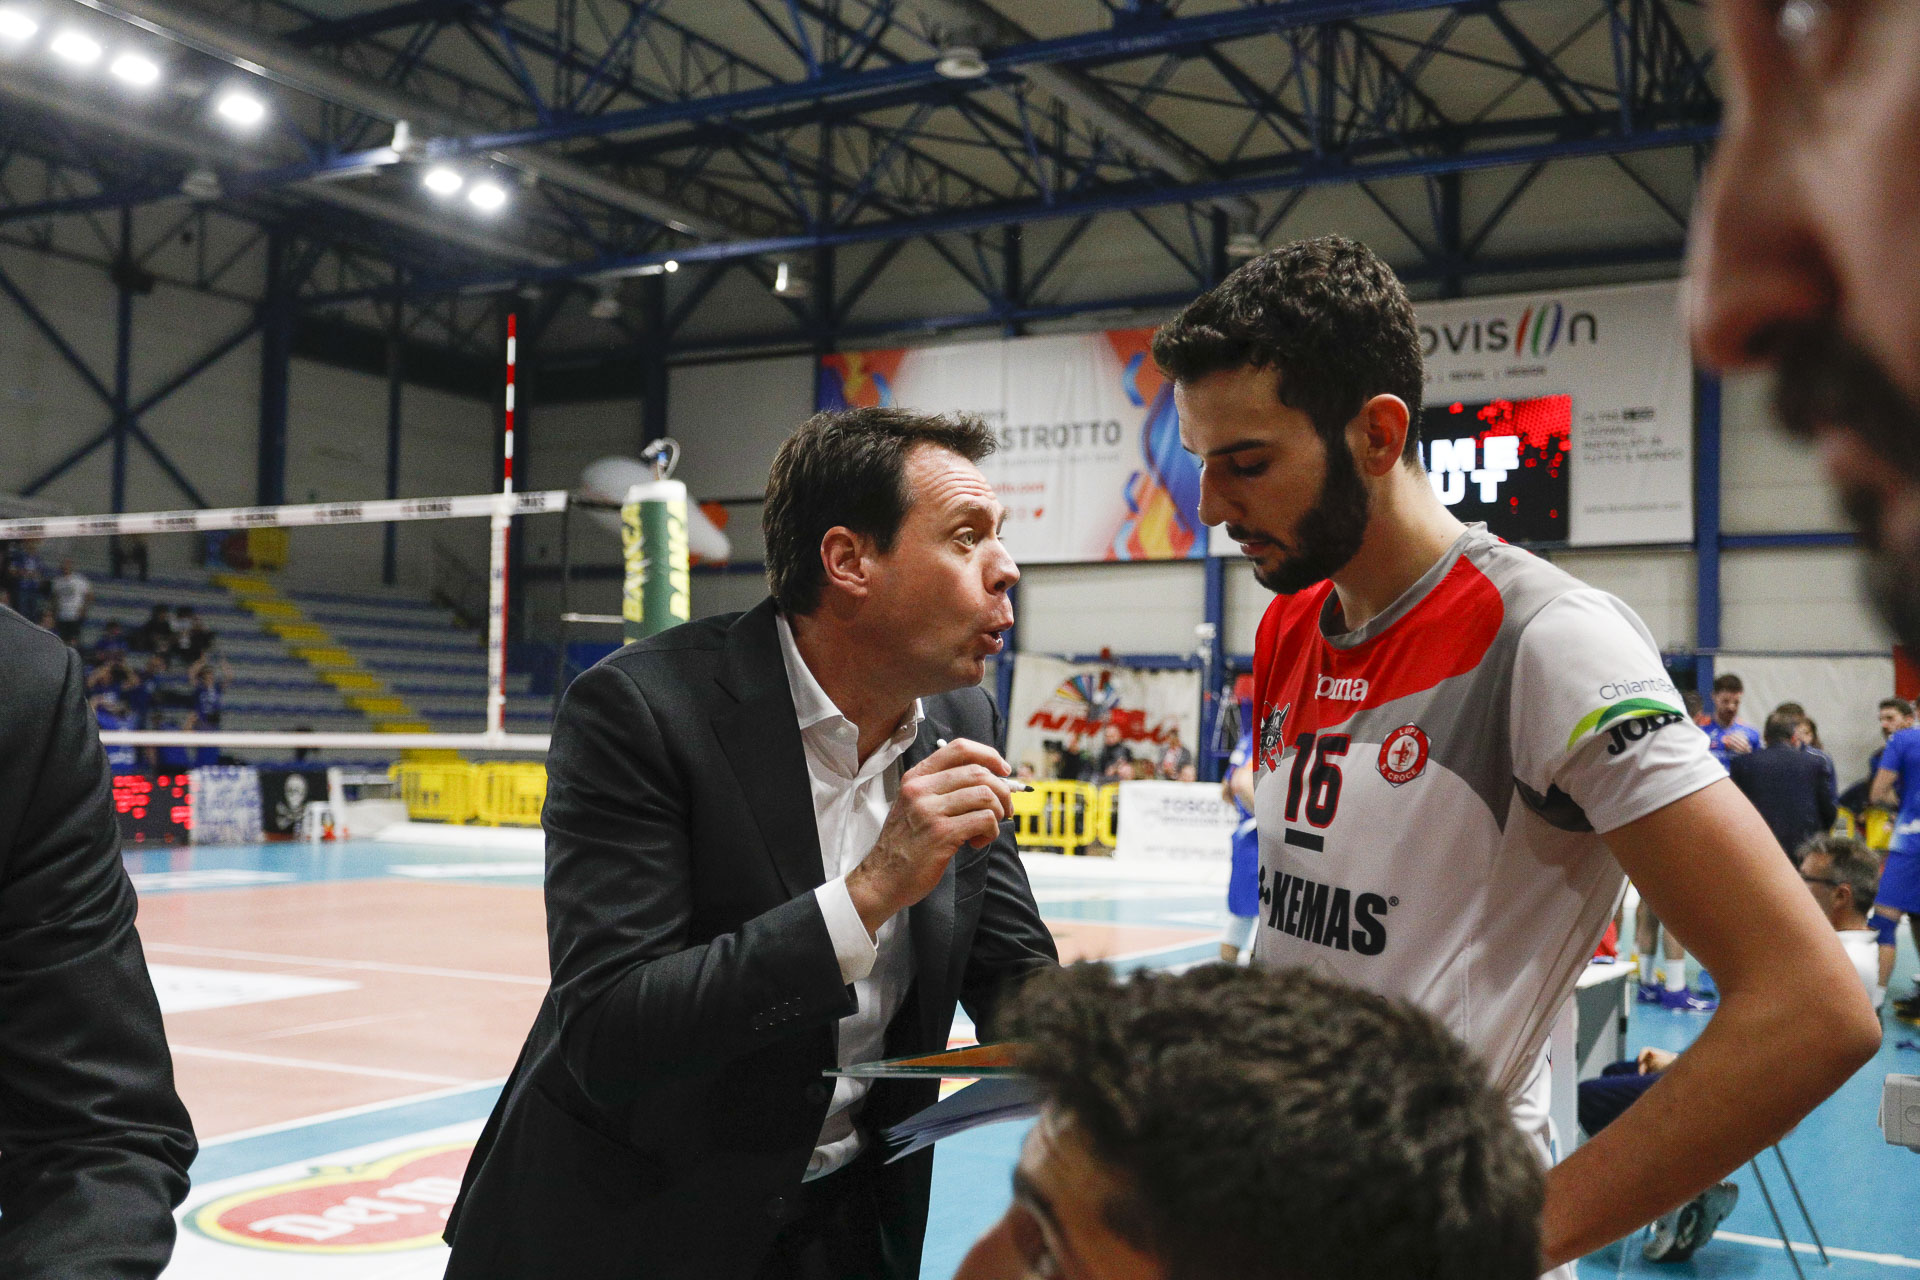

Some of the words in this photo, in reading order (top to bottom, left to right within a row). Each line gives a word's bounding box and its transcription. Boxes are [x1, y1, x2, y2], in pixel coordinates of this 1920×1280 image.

[667, 499, 691, 622] BANCA
[1399, 727, 1420, 737] LUPI
[1387, 767, 1418, 782] CROCE
